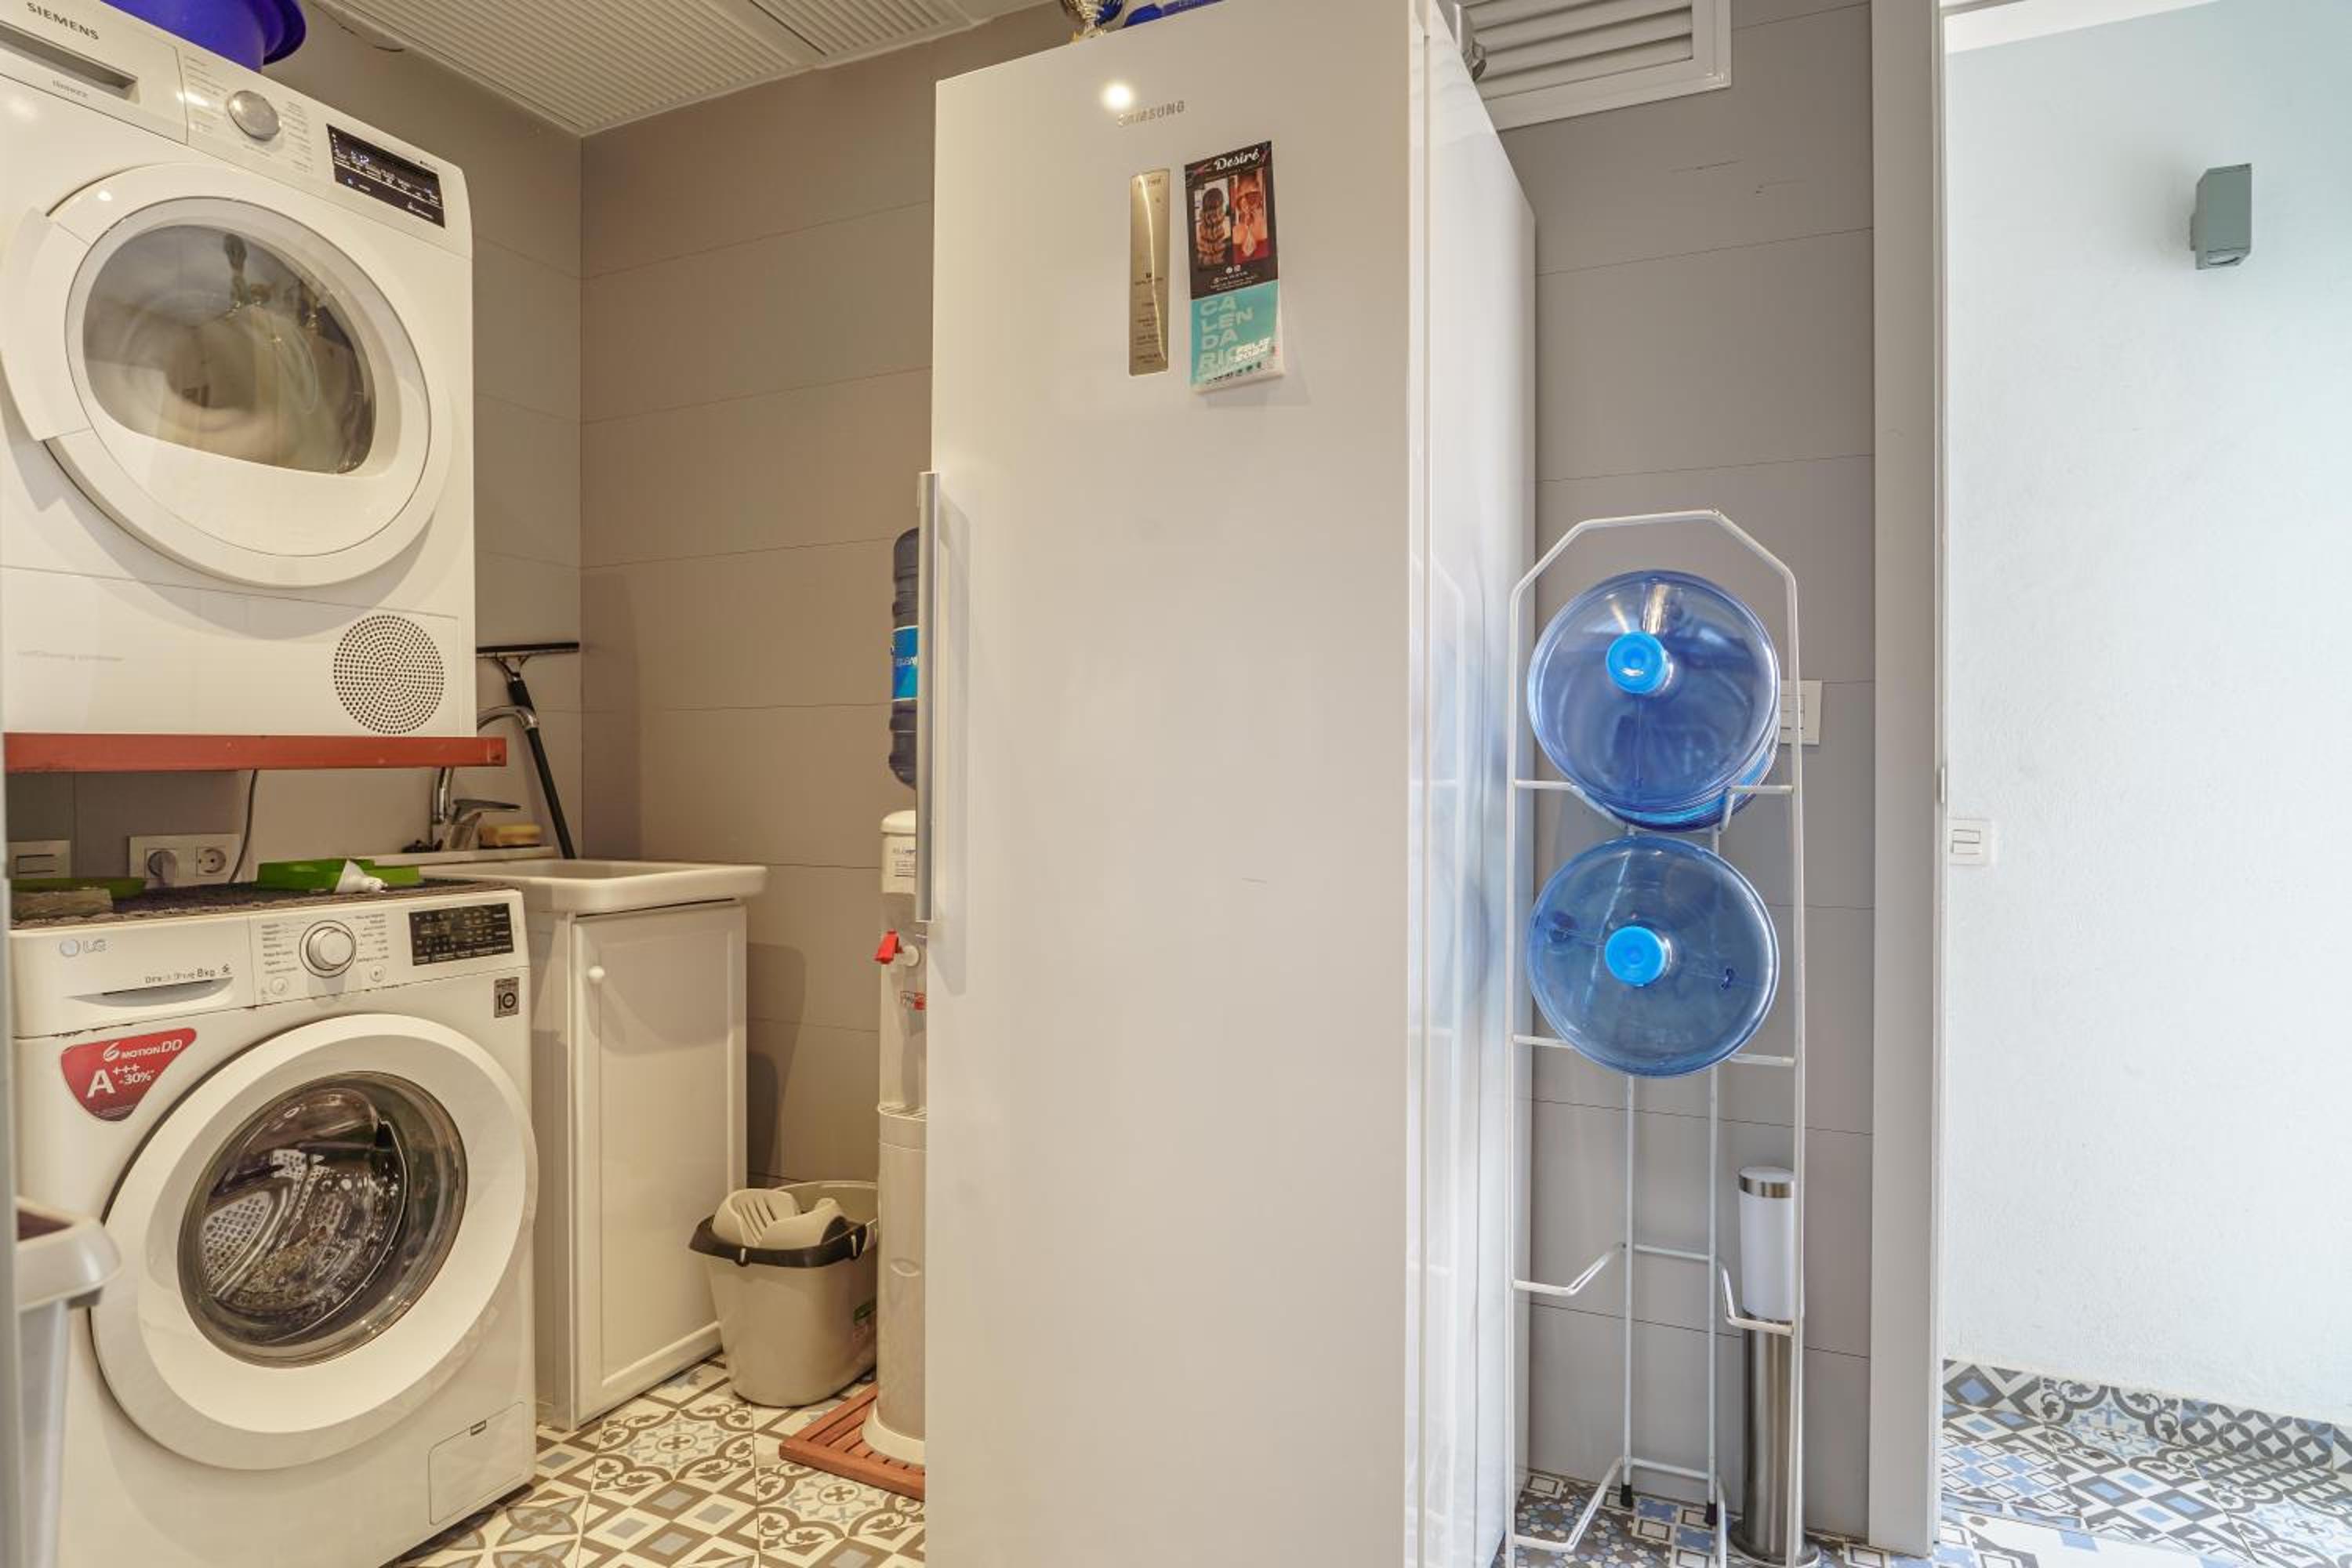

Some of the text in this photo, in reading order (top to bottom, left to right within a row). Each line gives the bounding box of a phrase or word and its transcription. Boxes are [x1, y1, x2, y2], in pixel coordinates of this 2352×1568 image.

[26, 2, 99, 40] SIEMENS
[1200, 296, 1237, 316] CA
[1201, 307, 1254, 333] LEN
[1202, 328, 1239, 350] DA
[82, 938, 107, 953] LG
[497, 992, 517, 1011] 10
